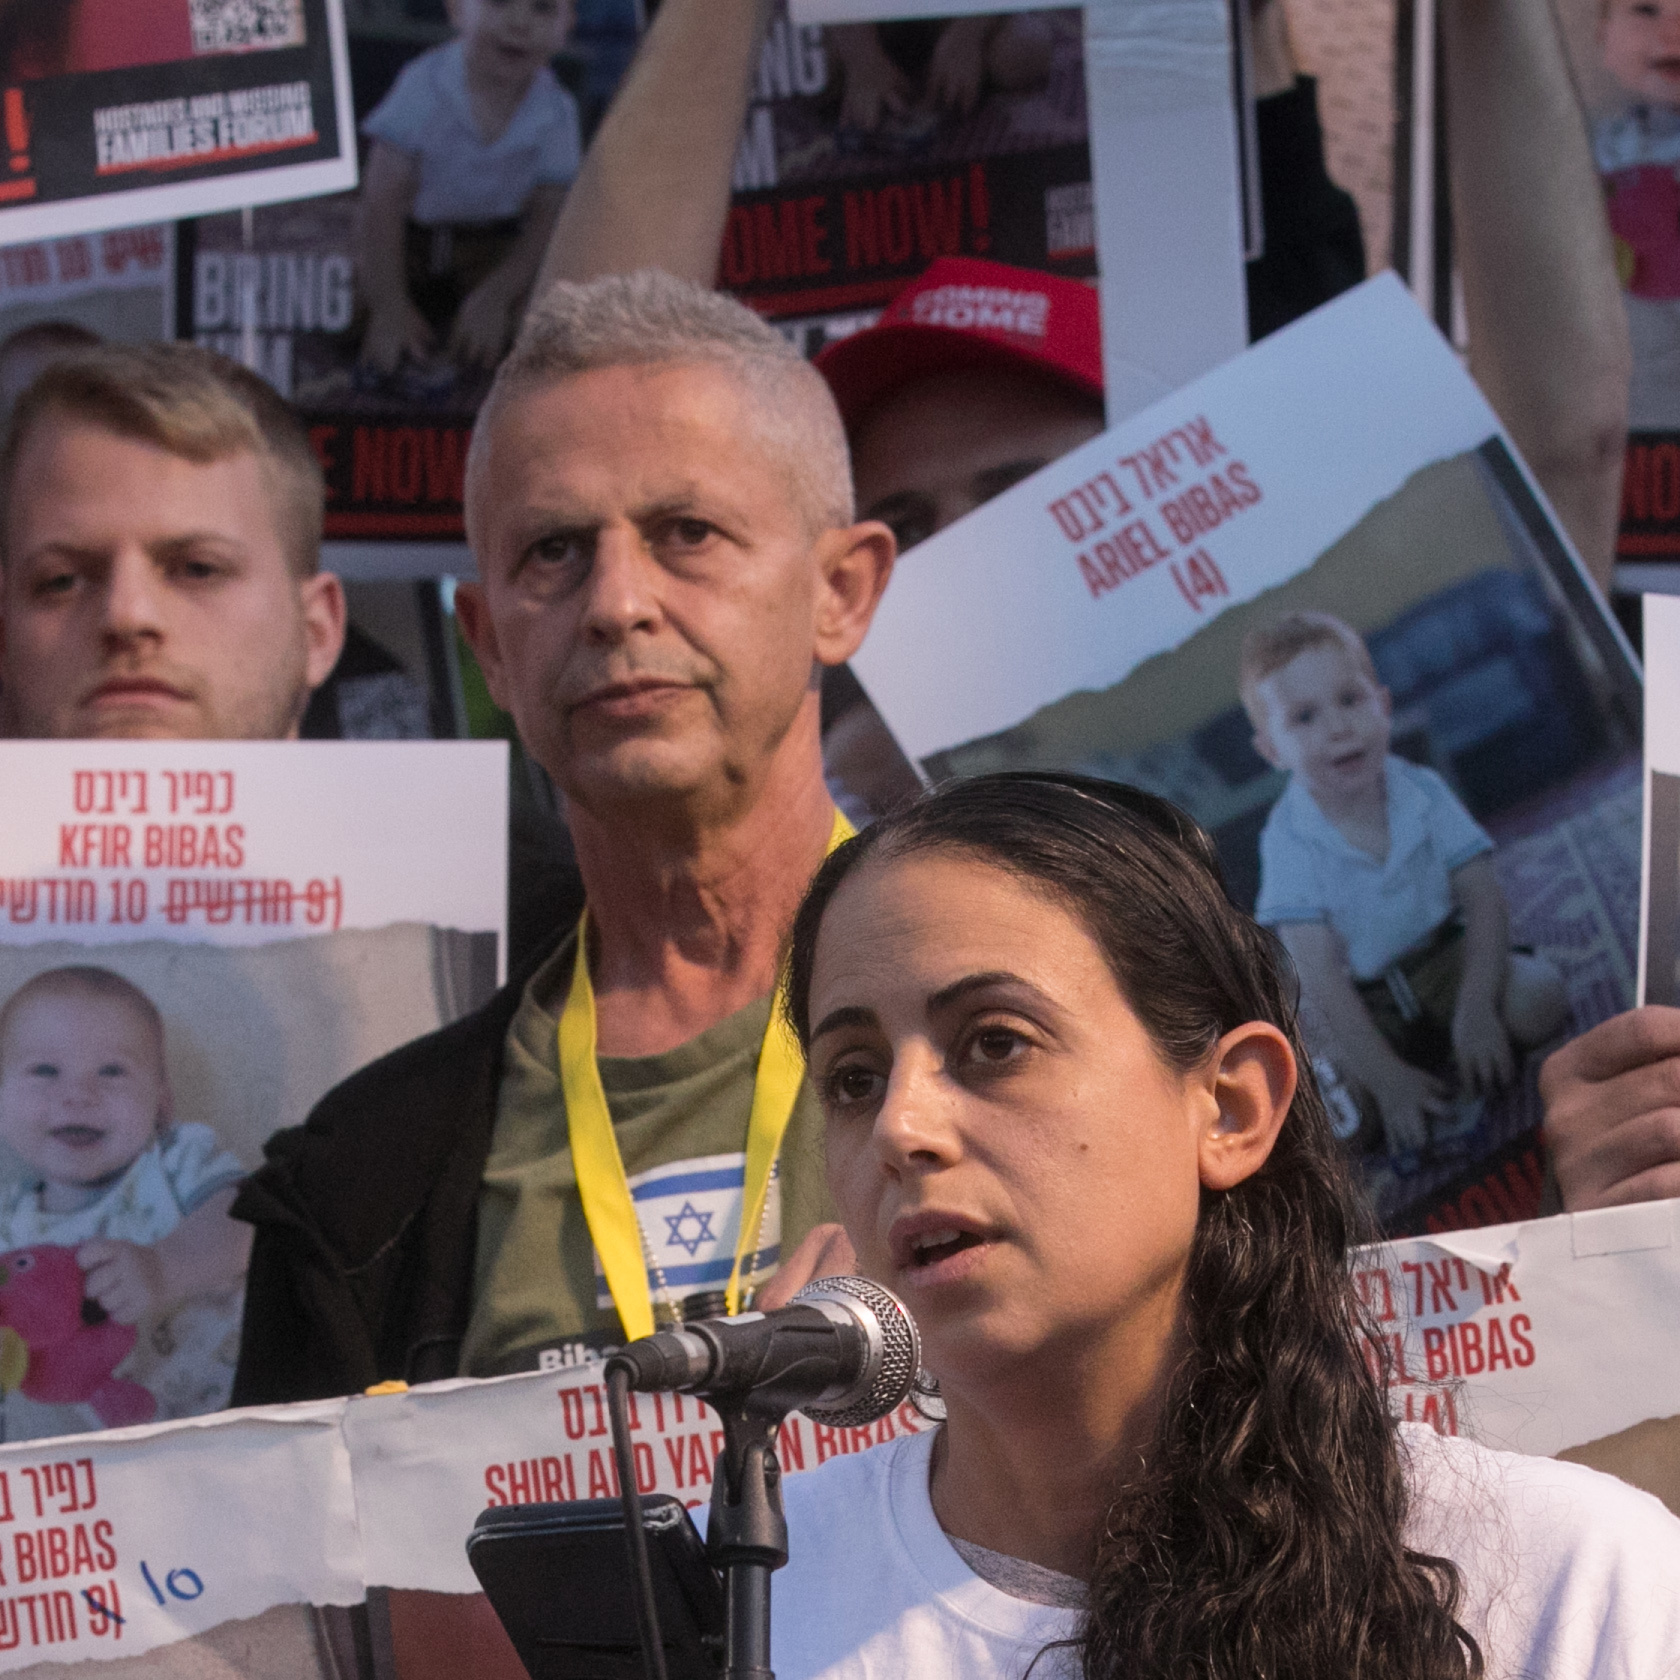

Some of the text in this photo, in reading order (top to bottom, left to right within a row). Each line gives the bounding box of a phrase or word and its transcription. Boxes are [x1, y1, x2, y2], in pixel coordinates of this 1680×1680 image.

[720, 195, 832, 285] OME
[843, 163, 993, 266] NOW!
[192, 252, 356, 336] BRING
[1047, 413, 1227, 545] אריאל ביבס
[1076, 461, 1263, 601] ARIEL BIBAS
[1169, 547, 1230, 613] (4)
[73, 770, 235, 816] כפיר ביבס
[58, 825, 246, 870] KFIR BIBAS
[108, 879, 147, 925] 10
[1423, 1313, 1536, 1381] BIBAS
[21, 1457, 97, 1518] כפיר
[485, 1453, 577, 1508] SHIRI
[13, 1519, 117, 1583] BIBAS
